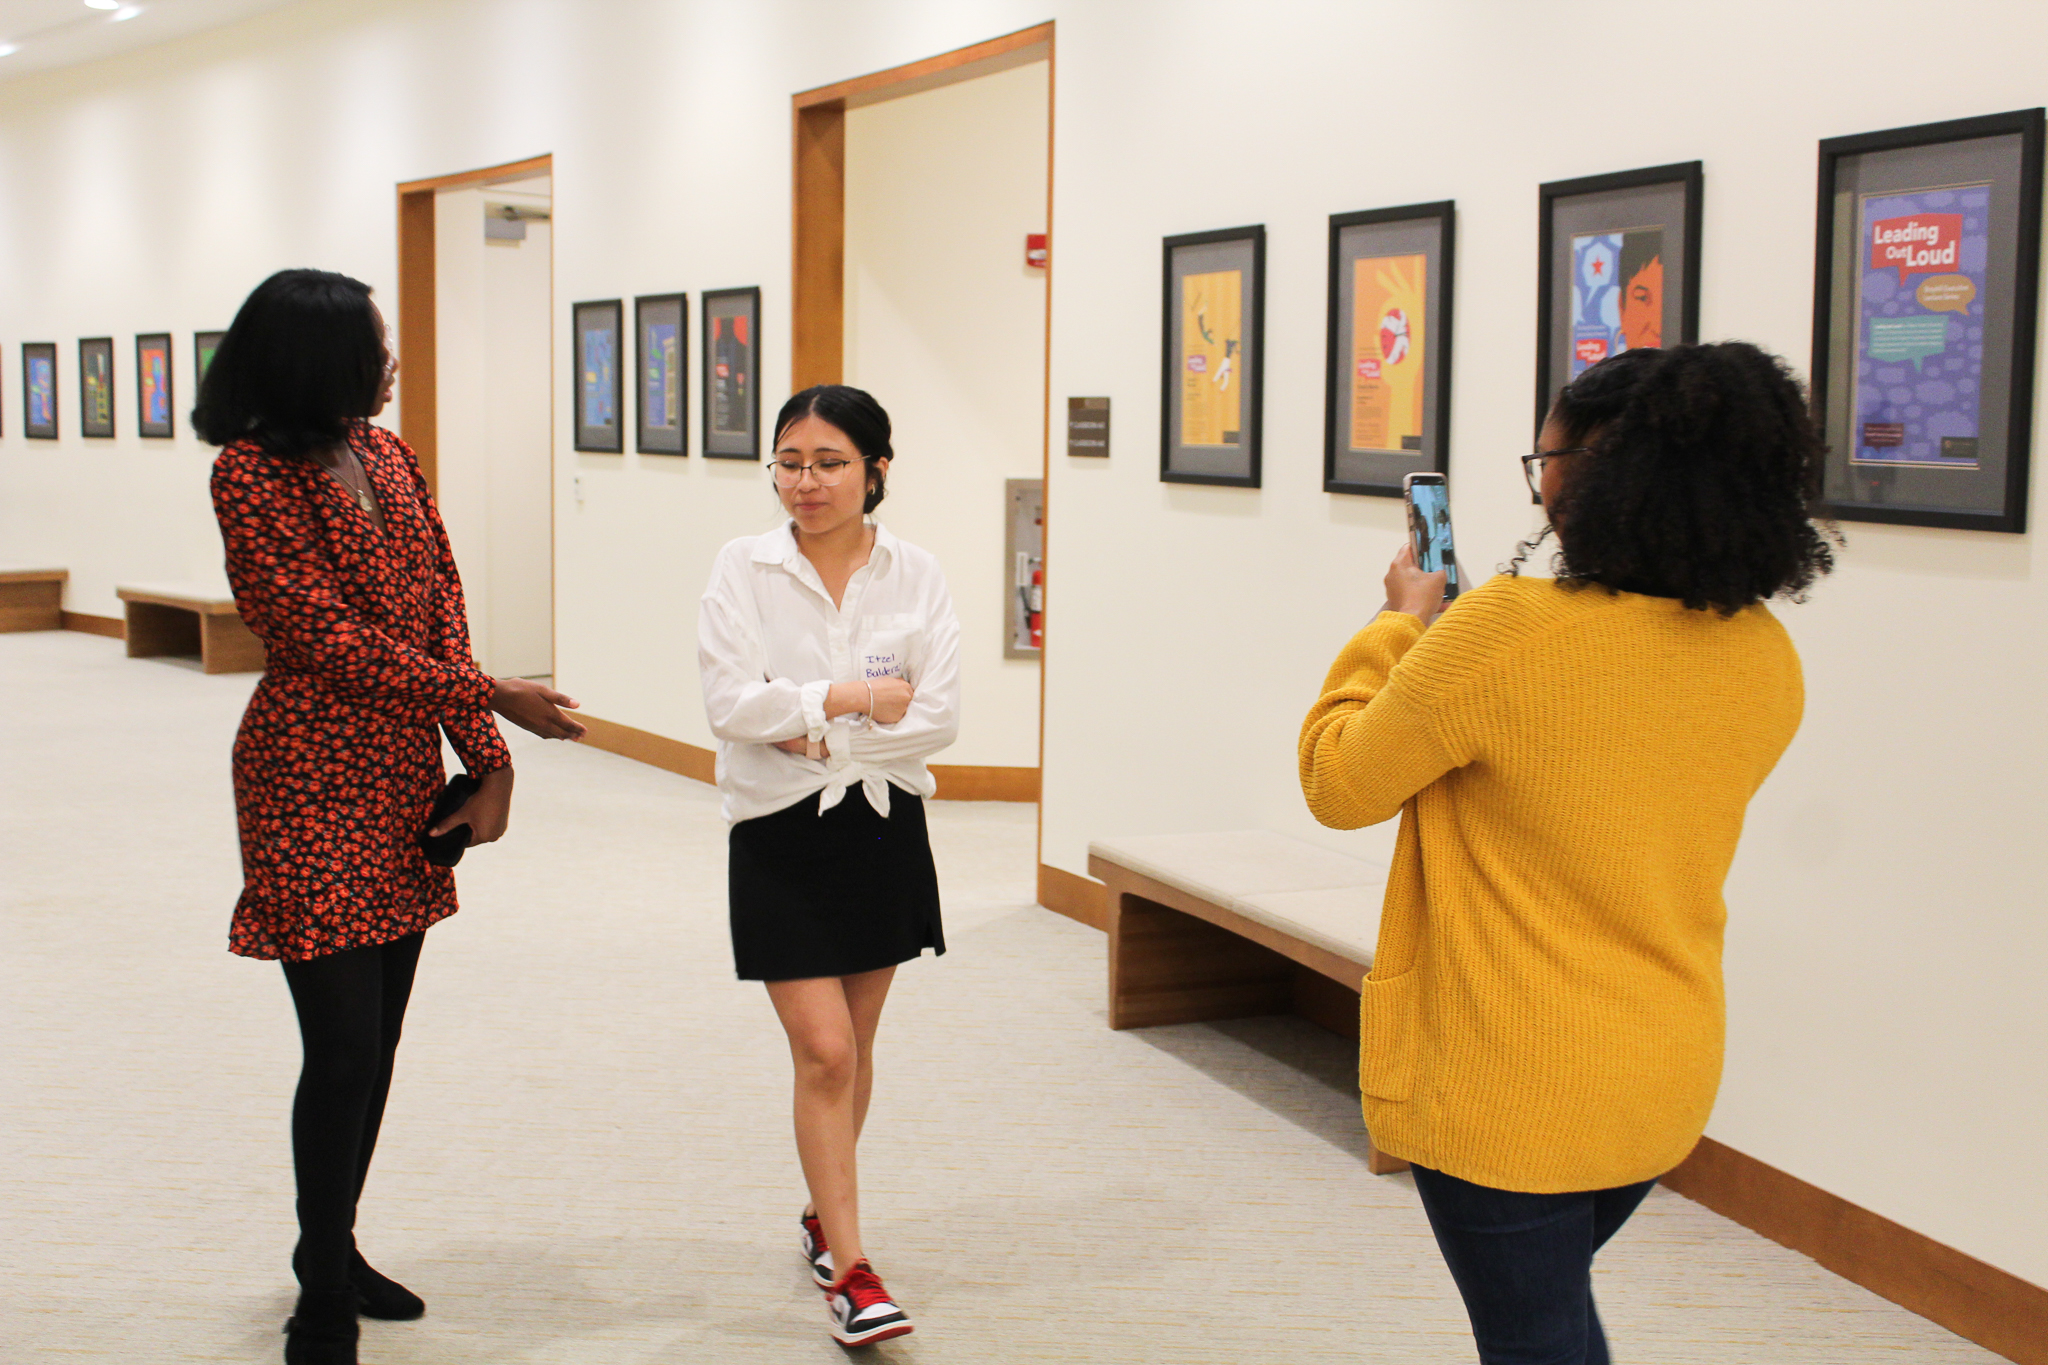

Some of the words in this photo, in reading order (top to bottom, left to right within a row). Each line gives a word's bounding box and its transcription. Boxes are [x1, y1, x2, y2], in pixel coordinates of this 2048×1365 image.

[1874, 221, 1938, 245] Leading
[1885, 246, 1906, 260] Out
[1906, 240, 1955, 267] Loud
[865, 653, 894, 663] Itzel
